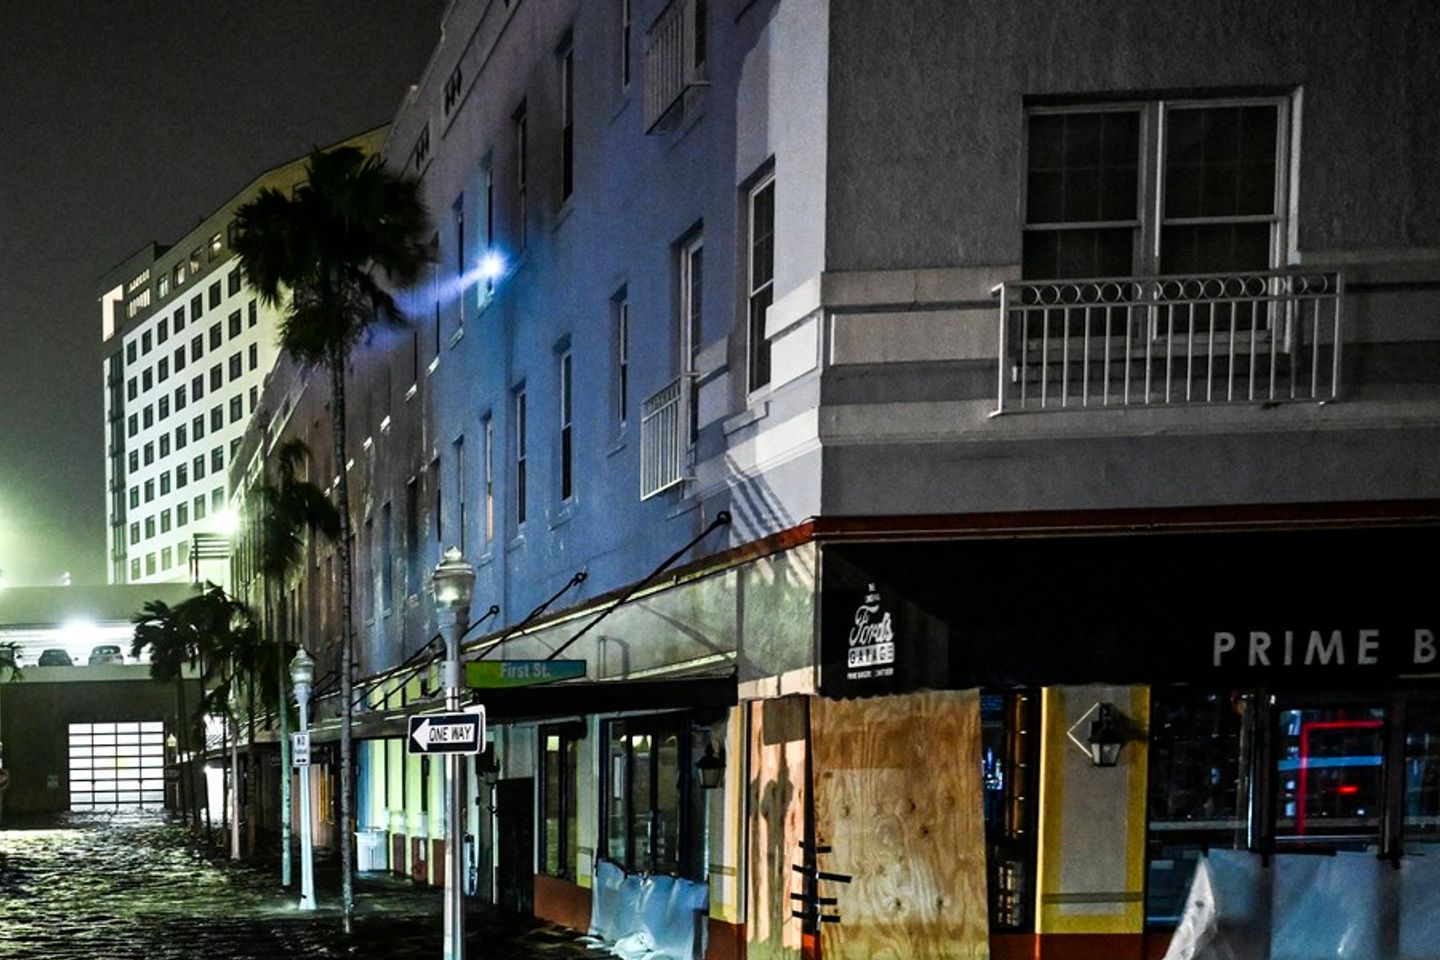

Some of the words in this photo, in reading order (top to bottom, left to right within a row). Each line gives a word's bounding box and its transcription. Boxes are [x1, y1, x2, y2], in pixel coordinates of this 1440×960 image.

[1212, 628, 1381, 667] PRIME
[500, 662, 530, 679] First
[532, 662, 551, 677] St.
[429, 724, 448, 742] ONE
[451, 723, 472, 741] WAY
